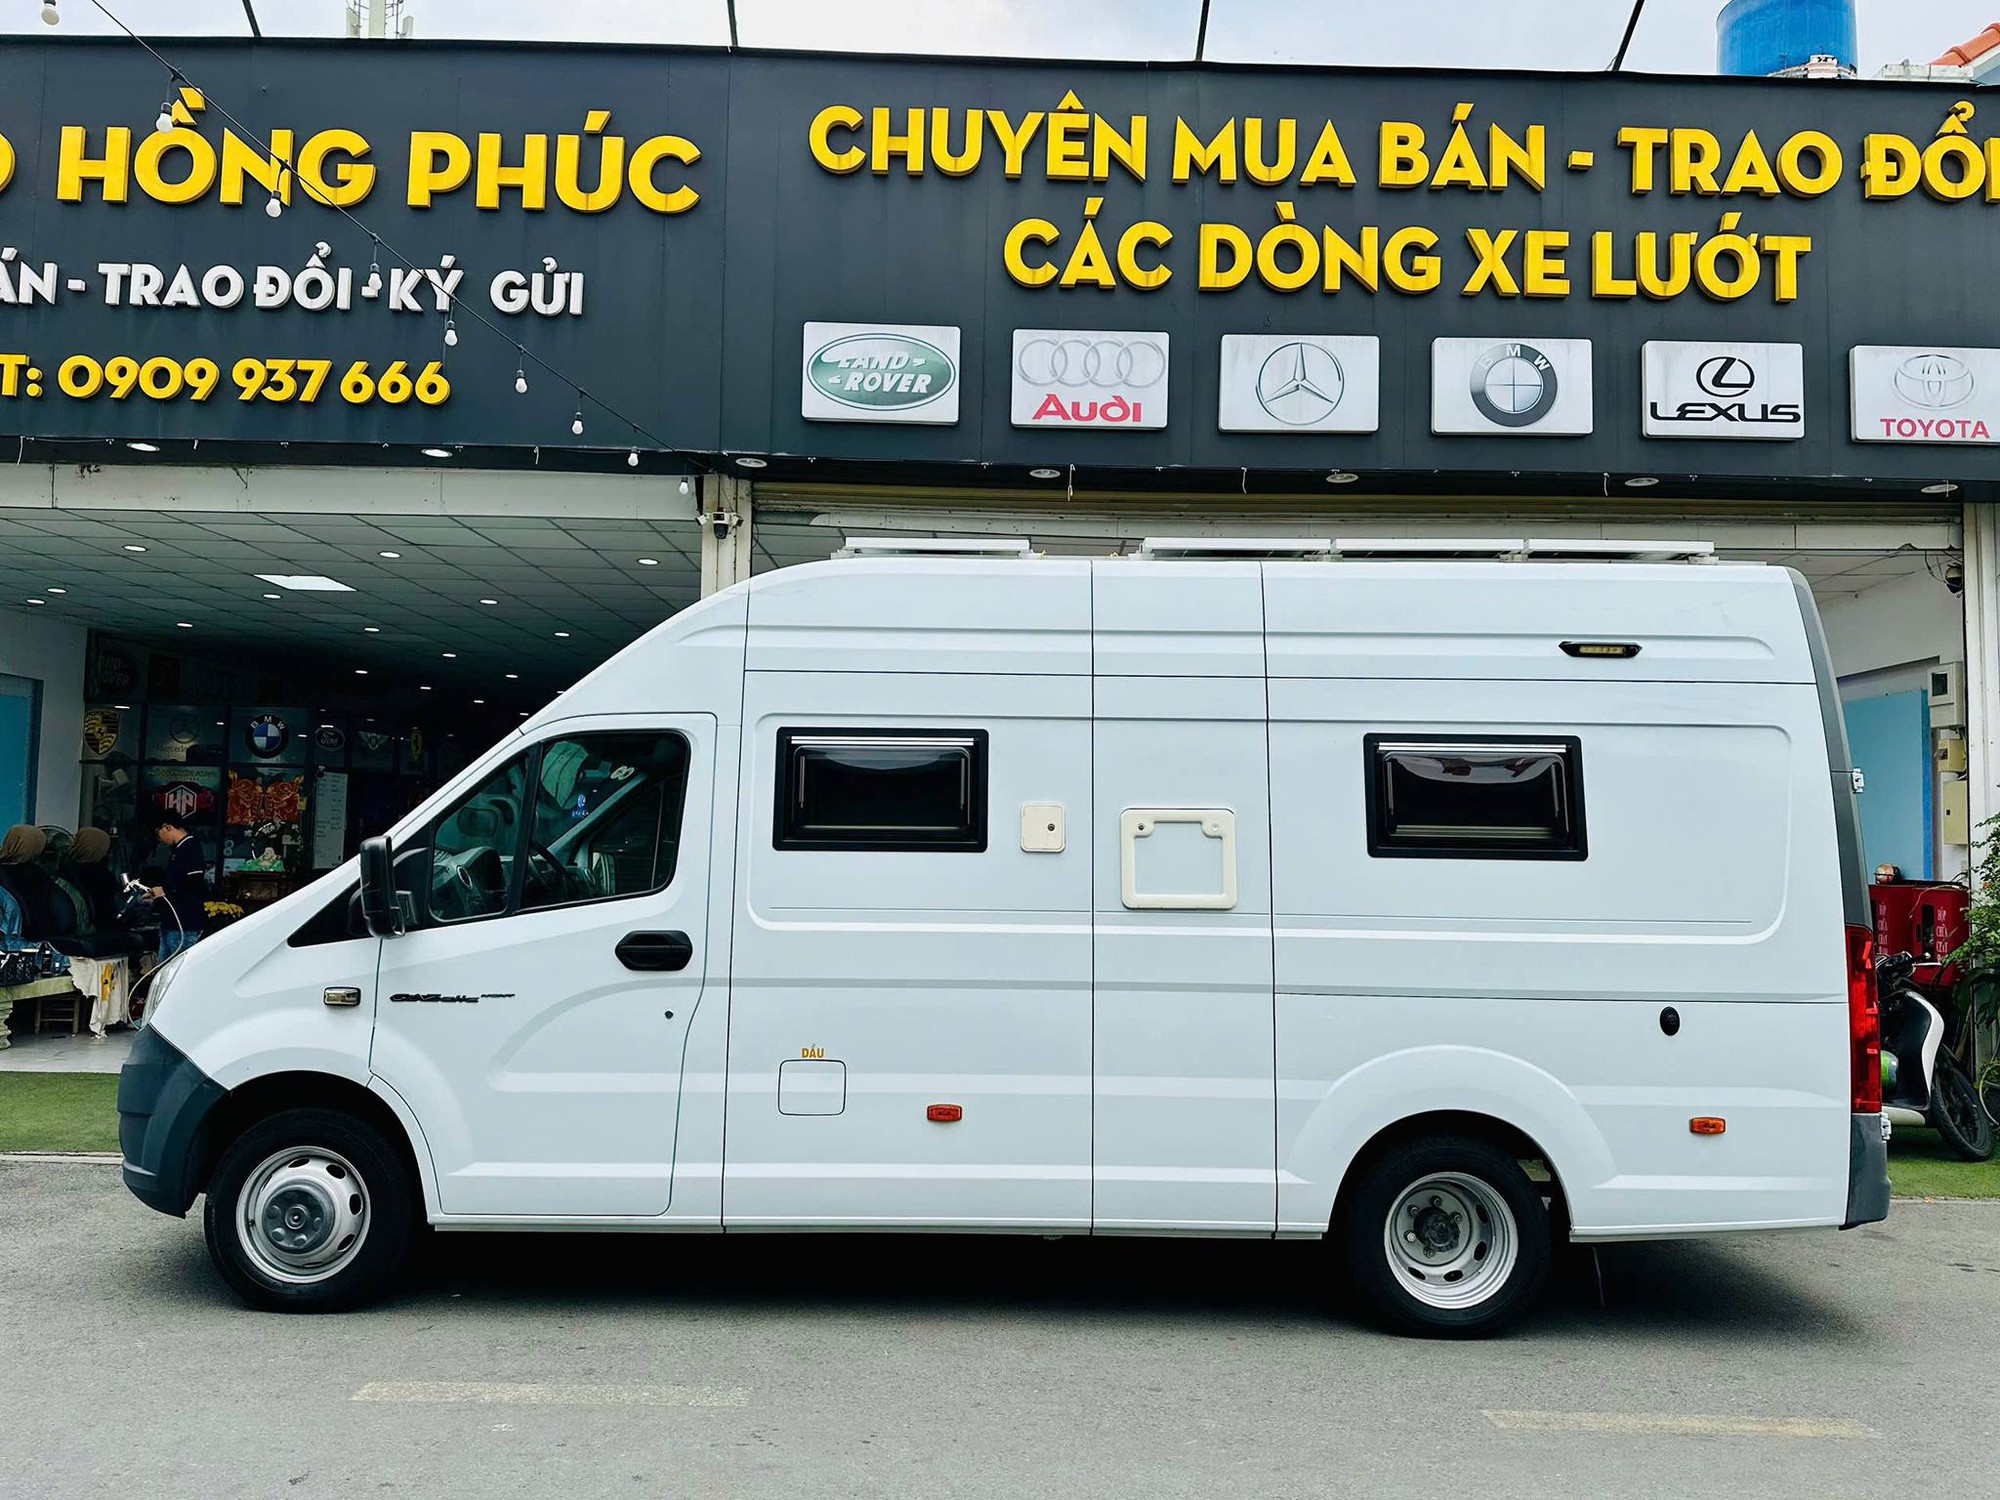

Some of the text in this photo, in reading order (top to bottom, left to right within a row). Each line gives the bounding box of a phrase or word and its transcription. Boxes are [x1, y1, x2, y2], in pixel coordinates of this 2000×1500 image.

[57, 87, 377, 207] HỒNG
[407, 110, 702, 214] PHÚC
[808, 89, 2000, 203] CHUYÊN MUA BÁN - TRAO ĐỔI
[1003, 196, 1813, 303] CÁC DÒNG XE LƯỚT
[97, 262, 245, 309] TRAO
[252, 241, 353, 311] ĐỔI
[388, 254, 465, 313] KÝ
[489, 256, 585, 316] GỬI
[837, 350, 910, 371] LAND
[57, 354, 221, 400] 0909
[231, 357, 333, 404] 937
[339, 360, 453, 406] 666
[843, 371, 933, 394] ROVER
[1649, 401, 1801, 423] LEXUS
[1880, 417, 1990, 439] TOYOTA
[250, 715, 286, 730] BMW
